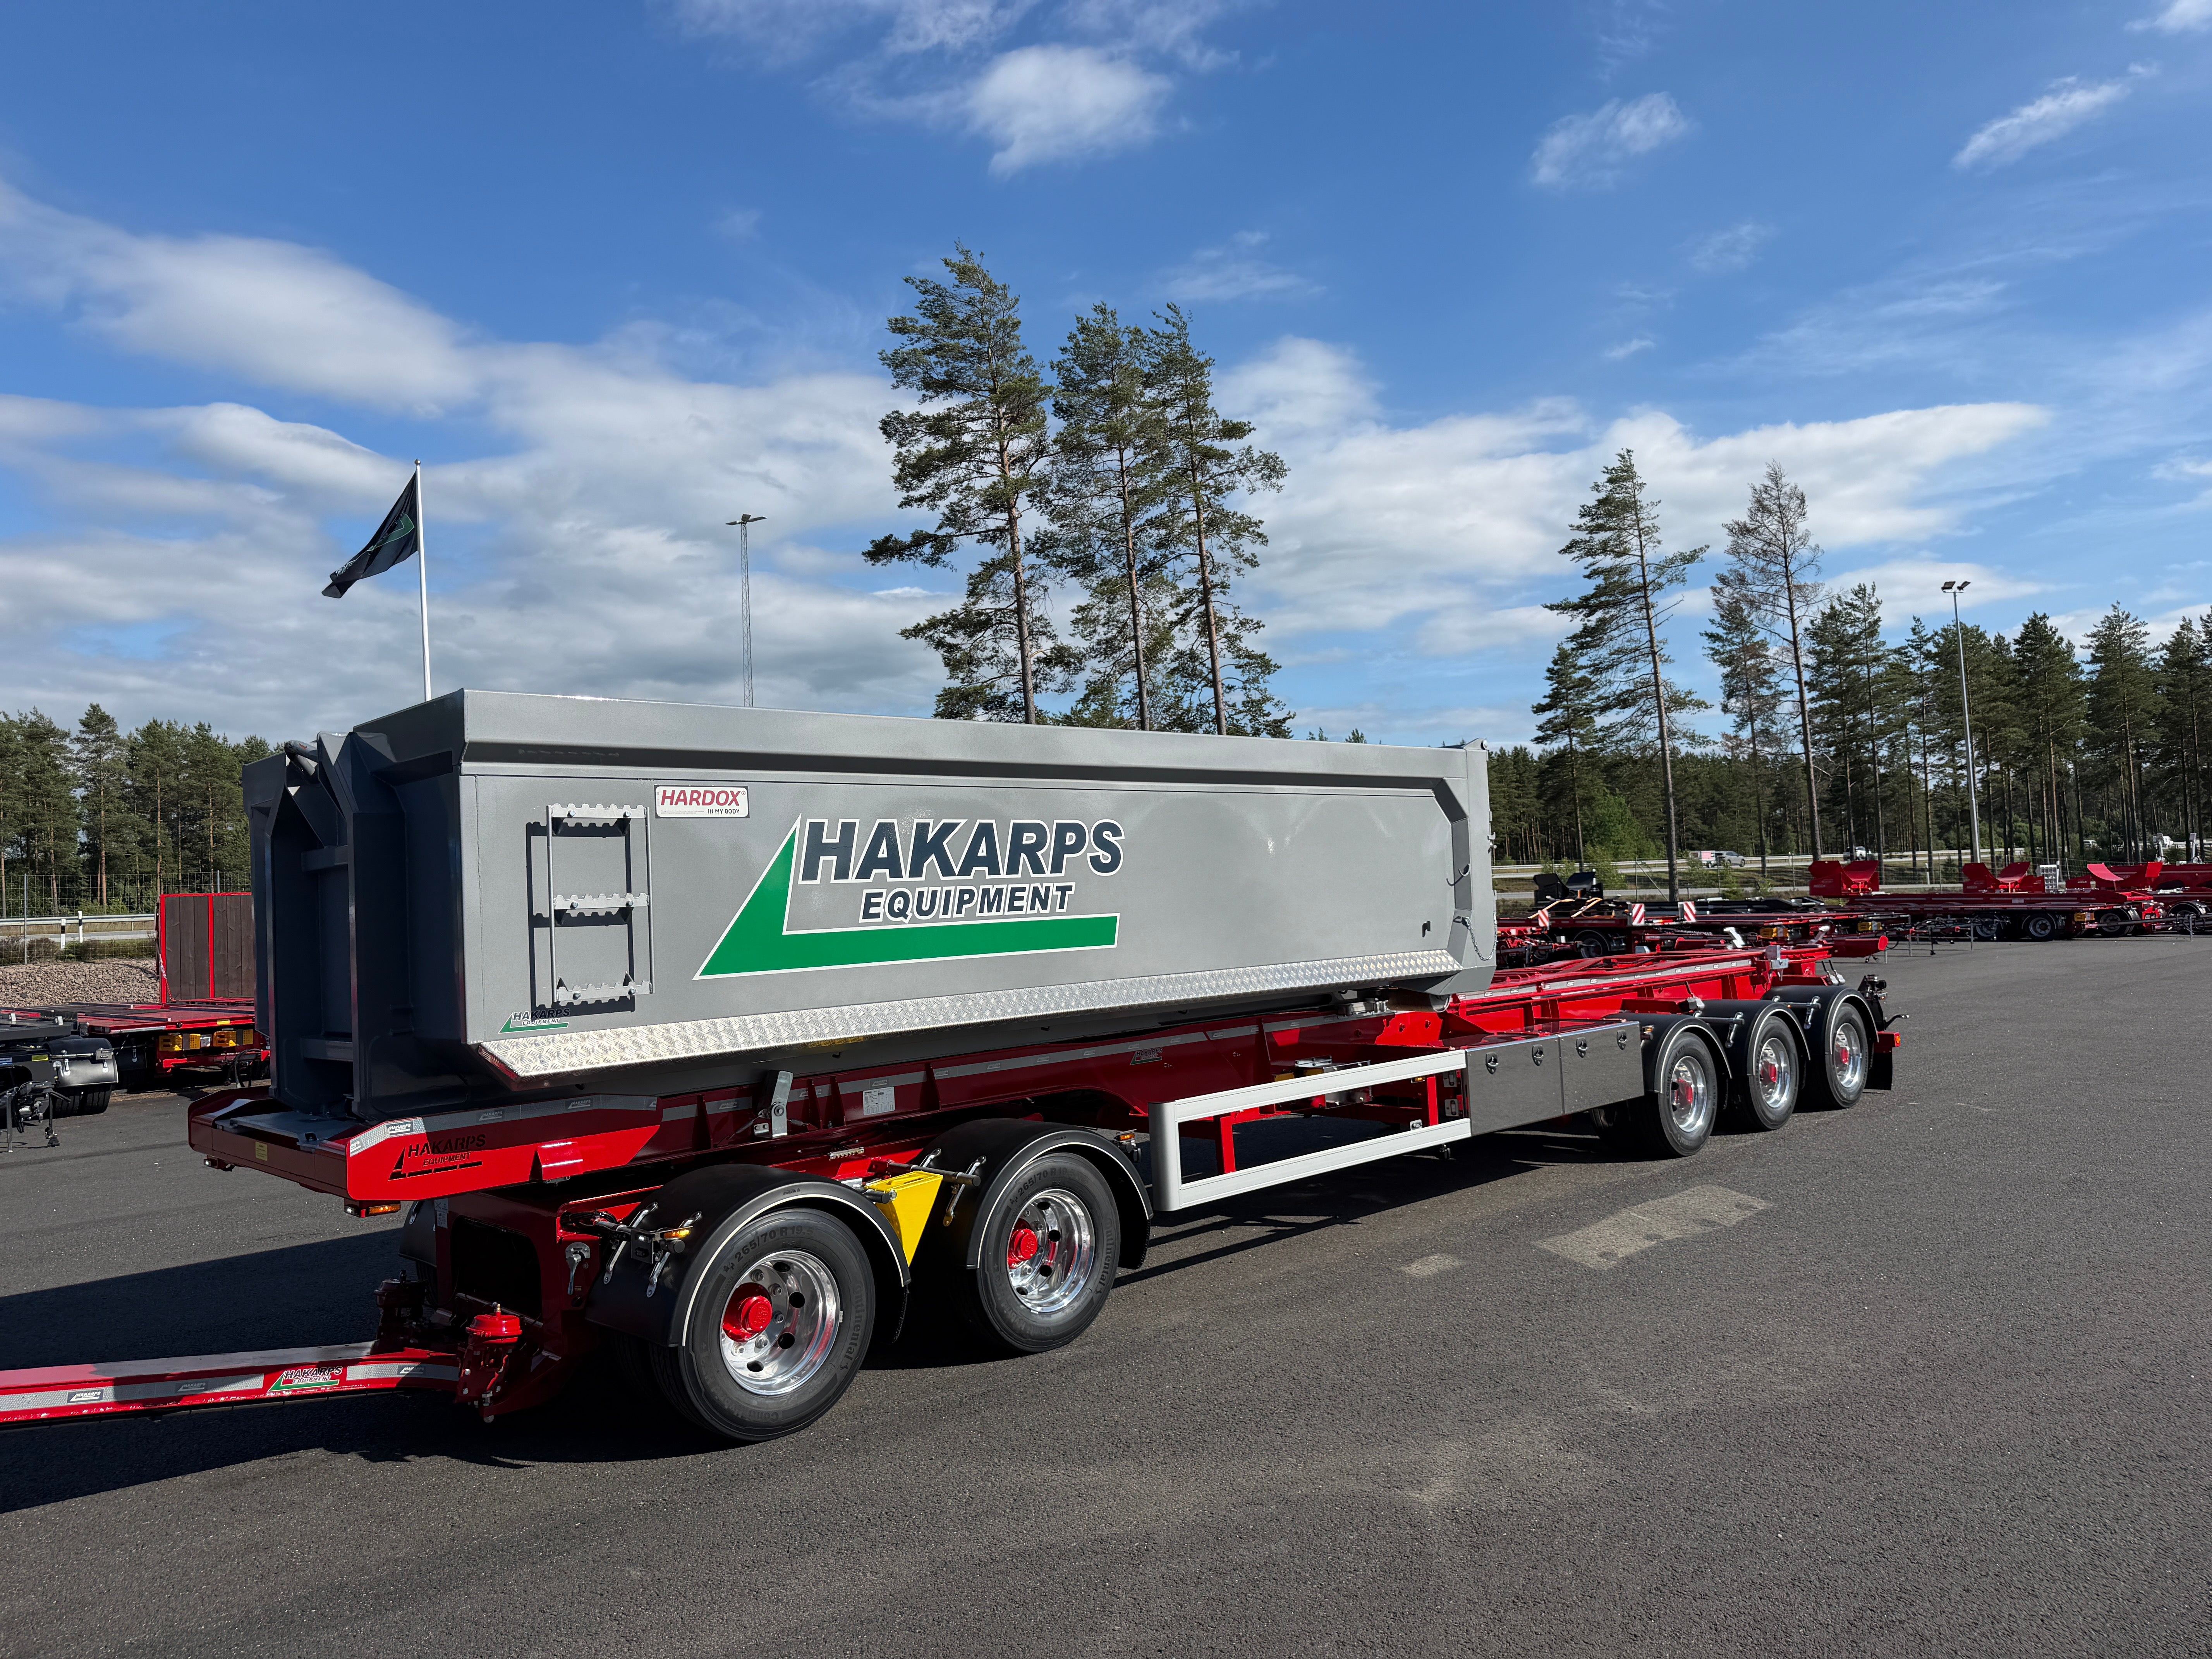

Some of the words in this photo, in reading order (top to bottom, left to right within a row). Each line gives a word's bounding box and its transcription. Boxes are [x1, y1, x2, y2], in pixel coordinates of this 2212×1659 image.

[661, 790, 741, 806] HARDOX
[799, 819, 1124, 884] HAKARPS
[859, 883, 1075, 923] EQUIPMENT
[512, 1008, 570, 1021] HAKARPS
[522, 1018, 560, 1026] EQUIPMENT
[1136, 1047, 1163, 1056] HAKARPS
[408, 1134, 486, 1158] HAKARPS
[423, 1152, 471, 1166] EQUIPMENT
[1018, 1170, 1048, 1196] 265/70
[735, 1230, 776, 1262] 265/70
[780, 1227, 788, 1236] R
[844, 1280, 865, 1360] Continental
[283, 1366, 343, 1379] HAKARPS
